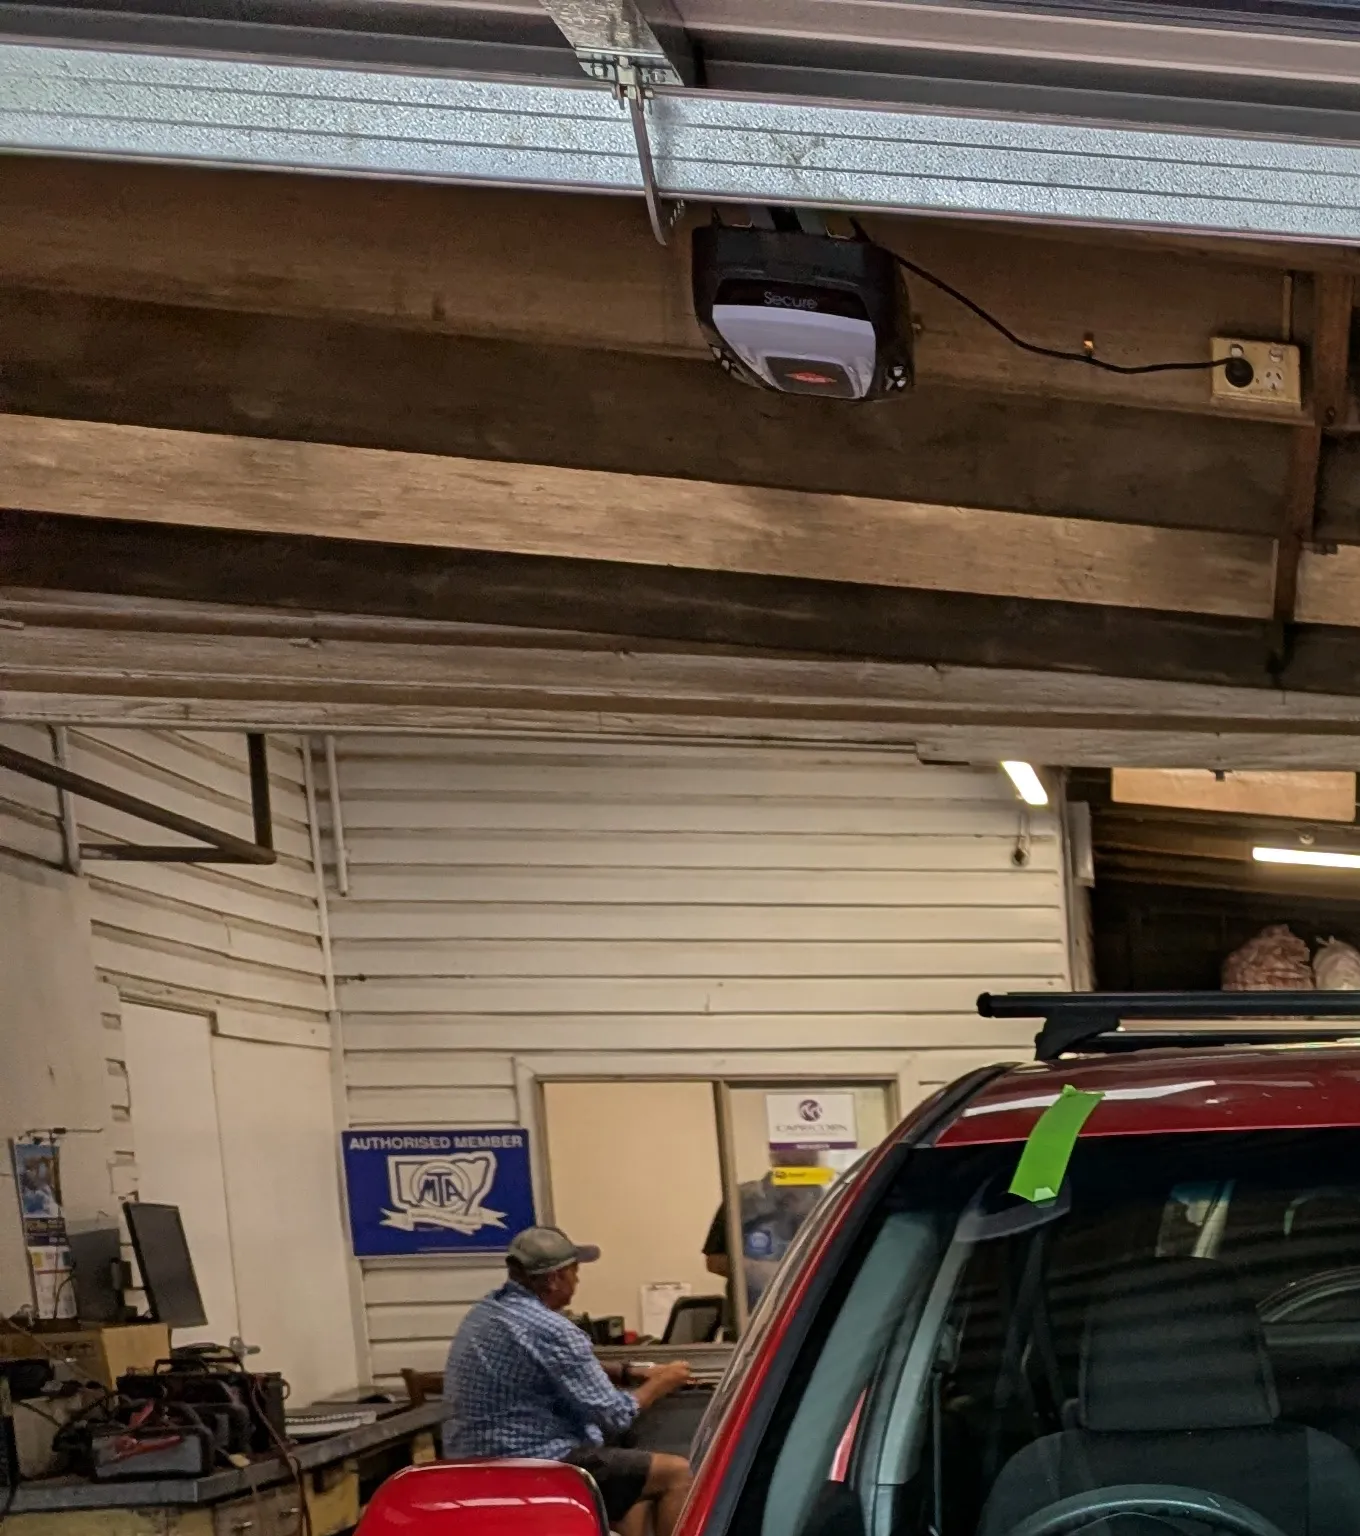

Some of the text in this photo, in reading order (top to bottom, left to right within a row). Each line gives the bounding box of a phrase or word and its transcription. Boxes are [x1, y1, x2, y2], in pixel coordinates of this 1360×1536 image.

[764, 291, 818, 310] Secure
[350, 1134, 523, 1150] AUTHORISED MEMBER
[418, 1172, 468, 1207] MTA
